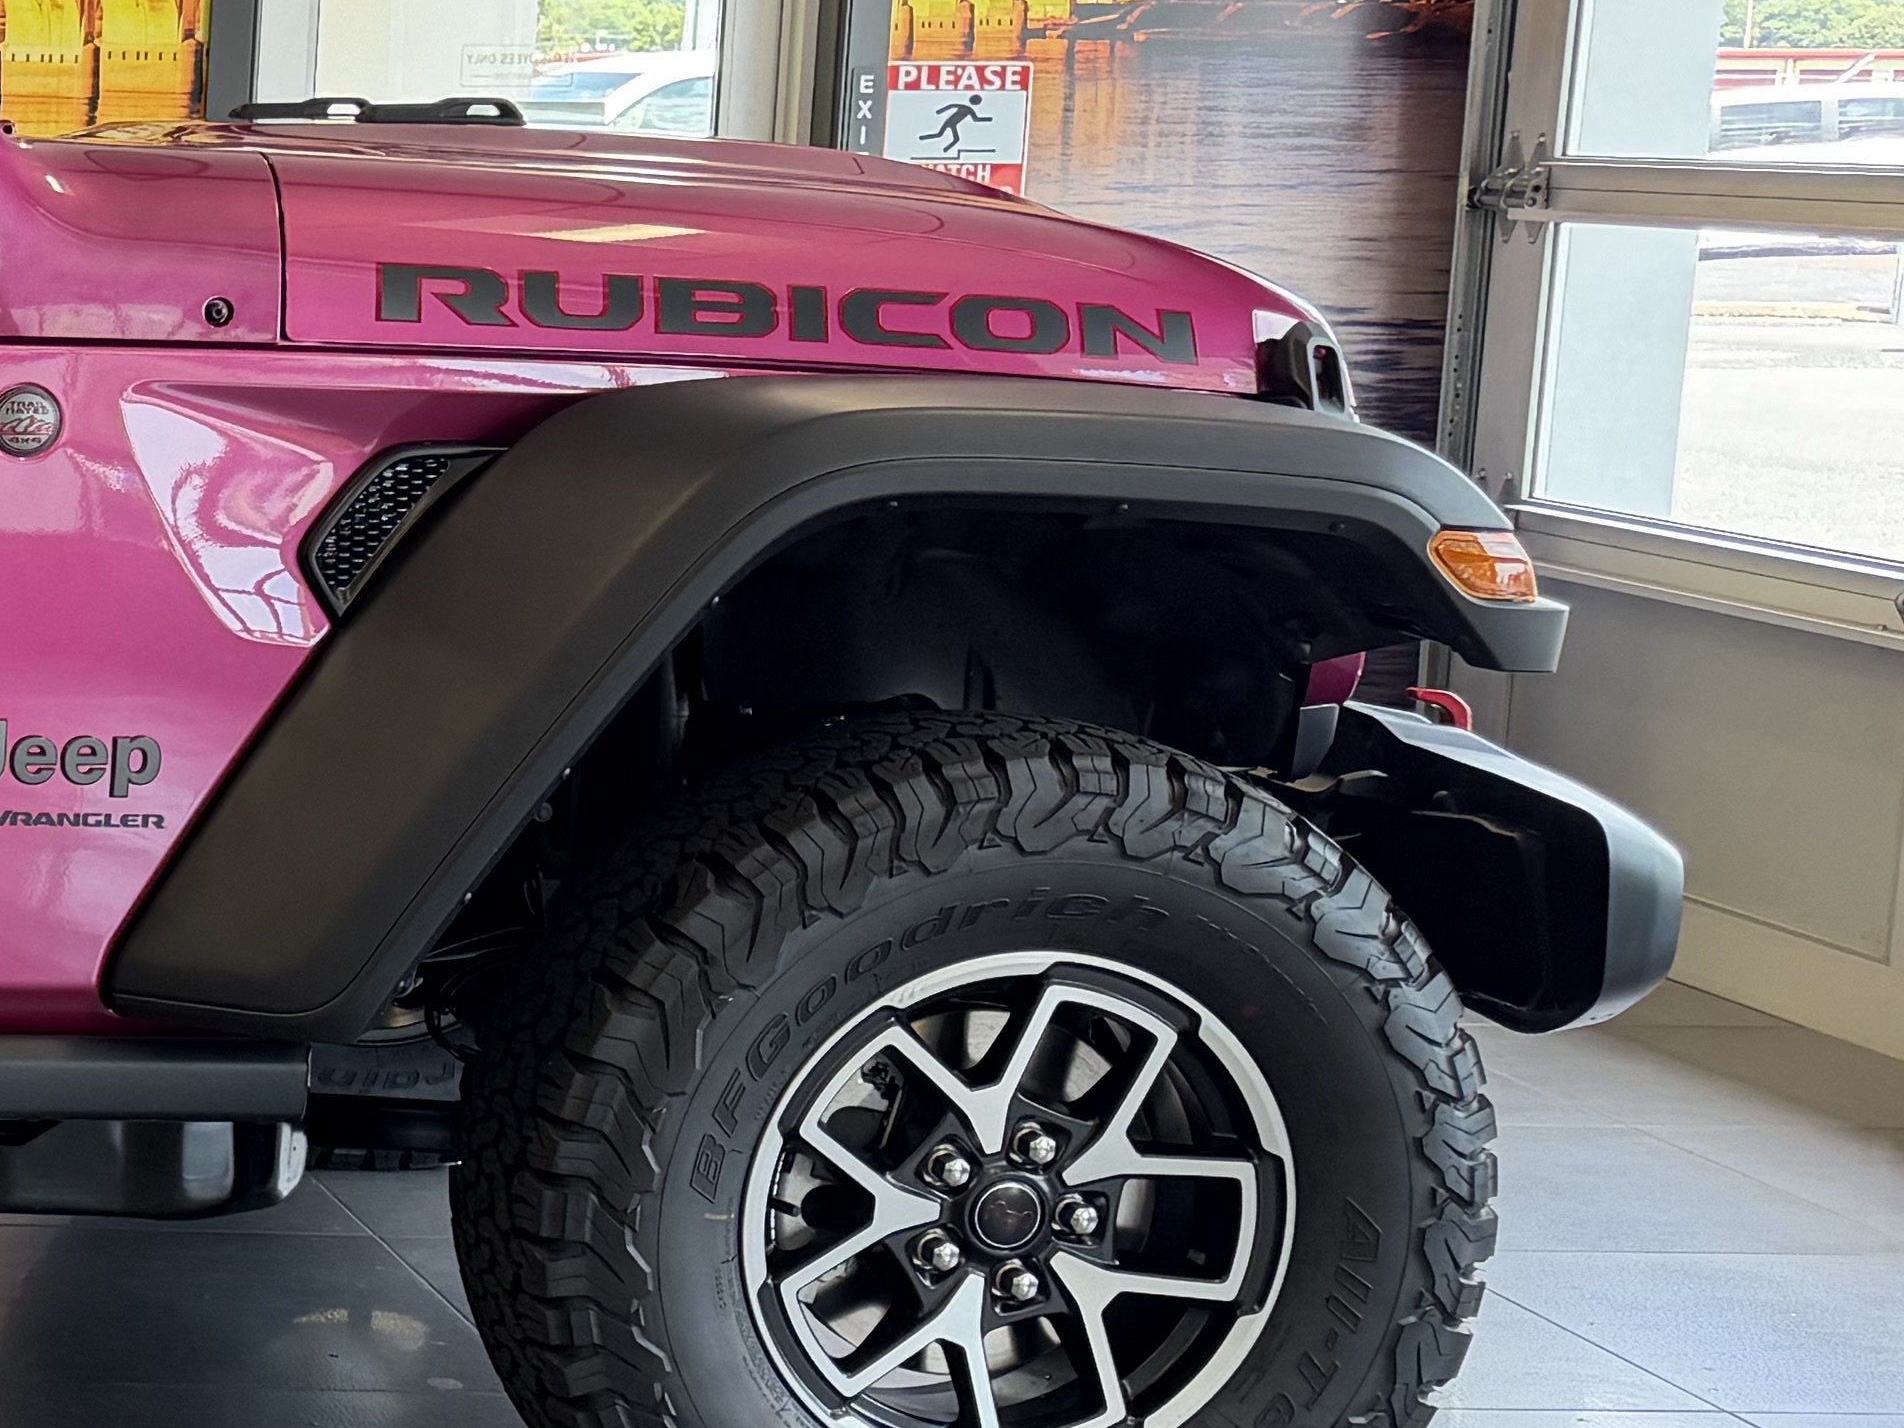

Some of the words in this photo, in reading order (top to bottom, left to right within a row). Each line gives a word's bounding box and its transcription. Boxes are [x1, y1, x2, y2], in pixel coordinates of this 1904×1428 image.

[856, 73, 876, 156] EXI
[897, 65, 1023, 91] PLEASE
[375, 262, 1198, 365] RUBICON
